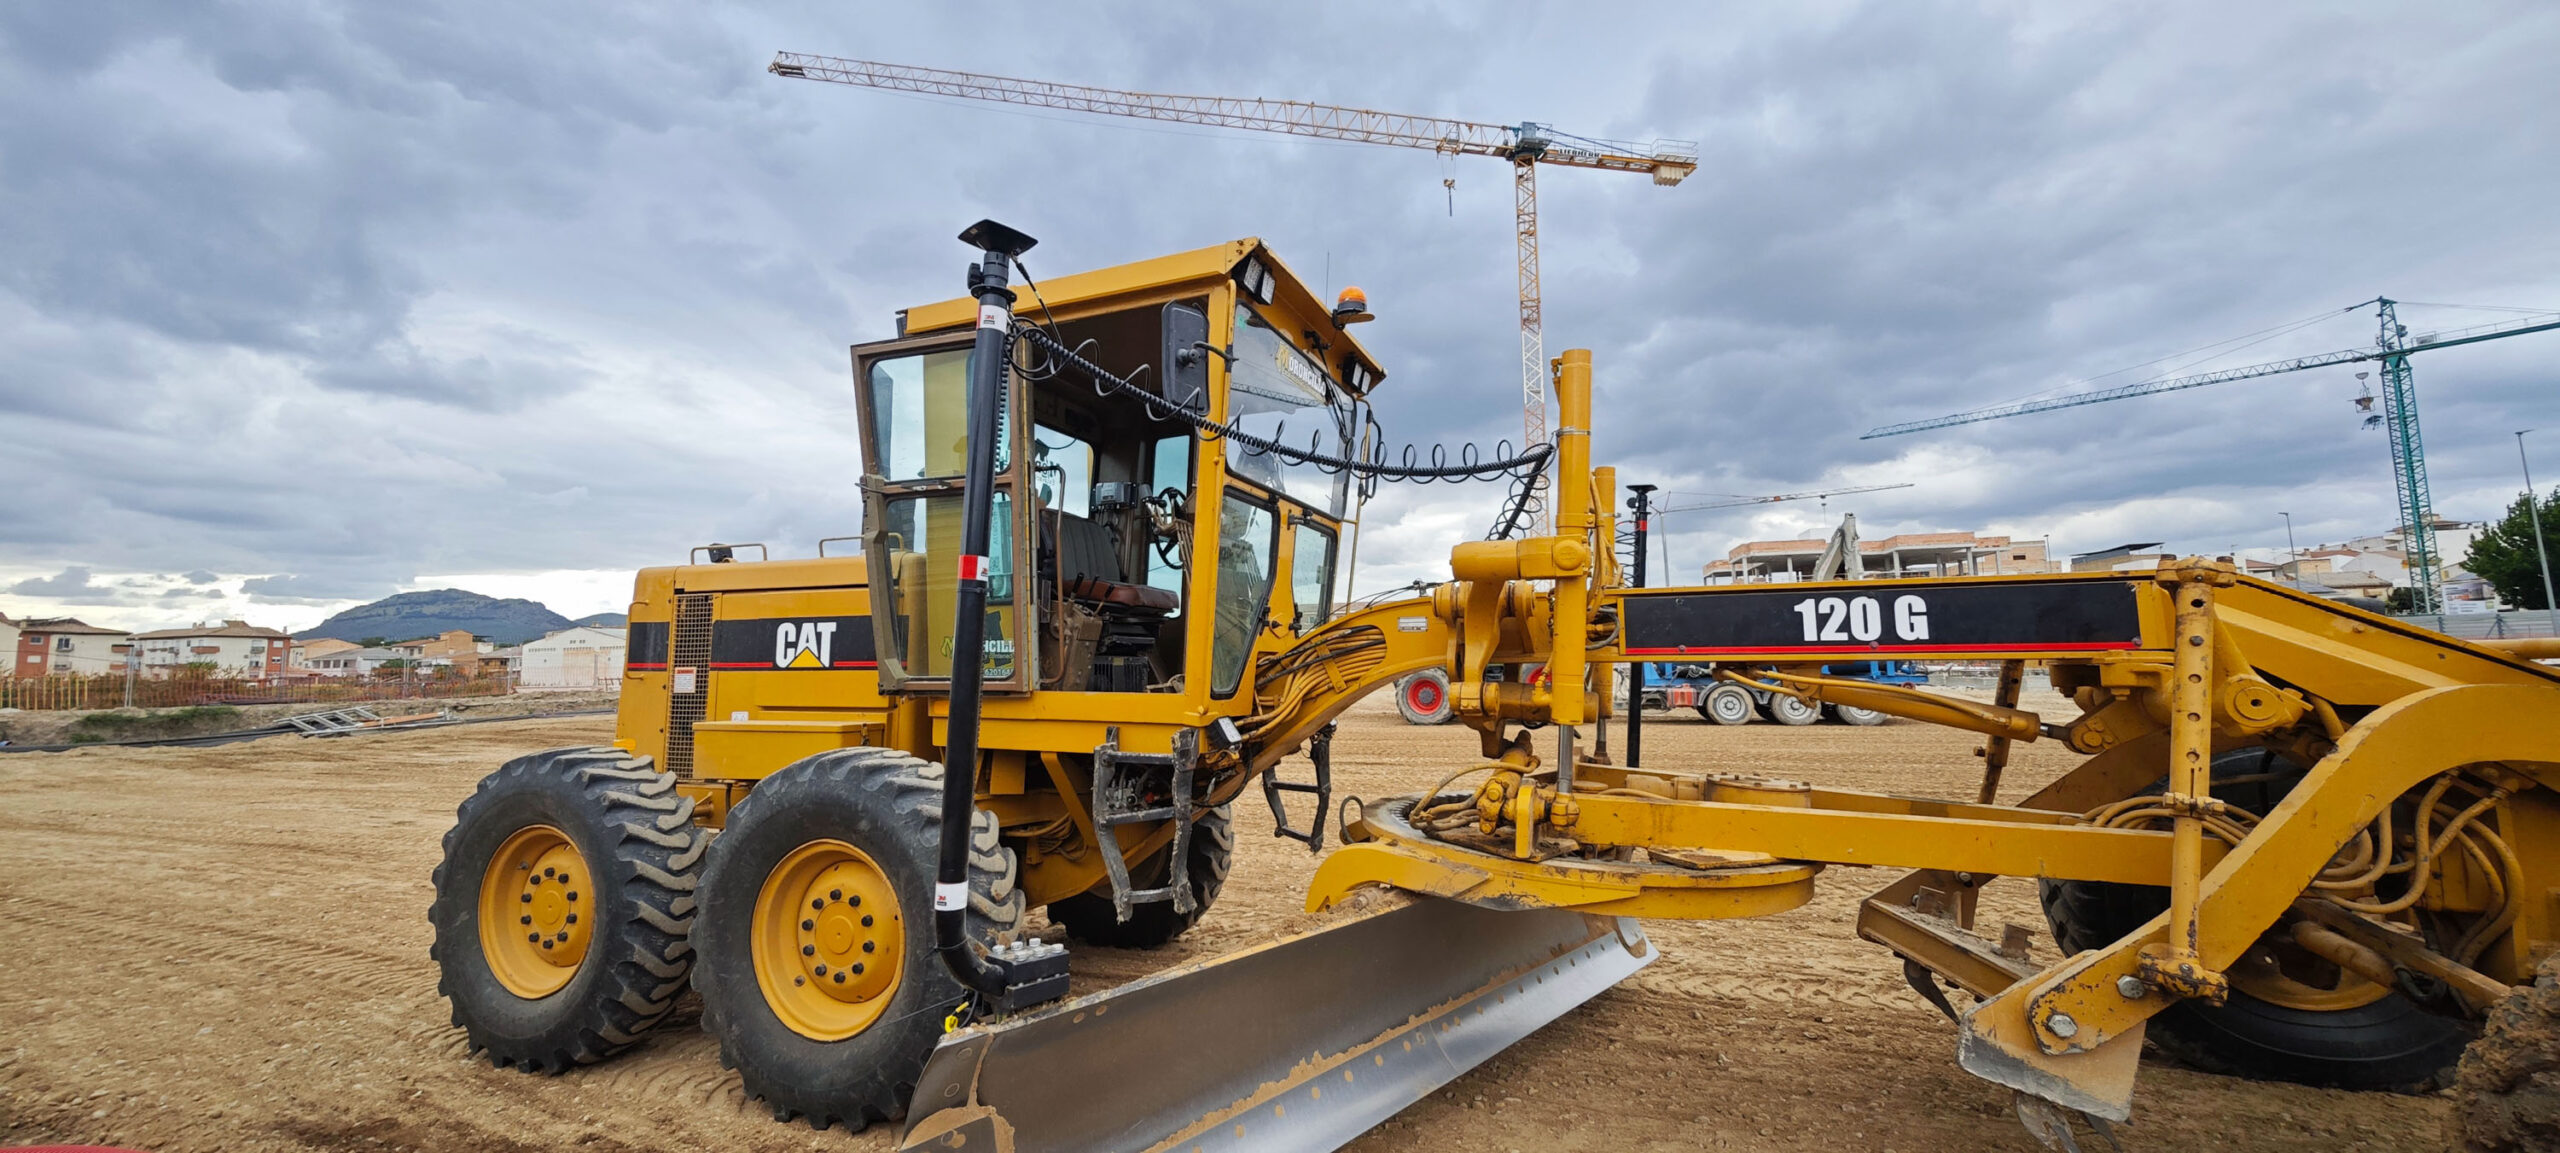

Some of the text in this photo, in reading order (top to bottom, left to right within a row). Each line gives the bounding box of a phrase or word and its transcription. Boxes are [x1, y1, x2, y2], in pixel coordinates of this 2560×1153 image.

[1793, 594, 1930, 641] 120 G
[775, 622, 837, 668] CAT
